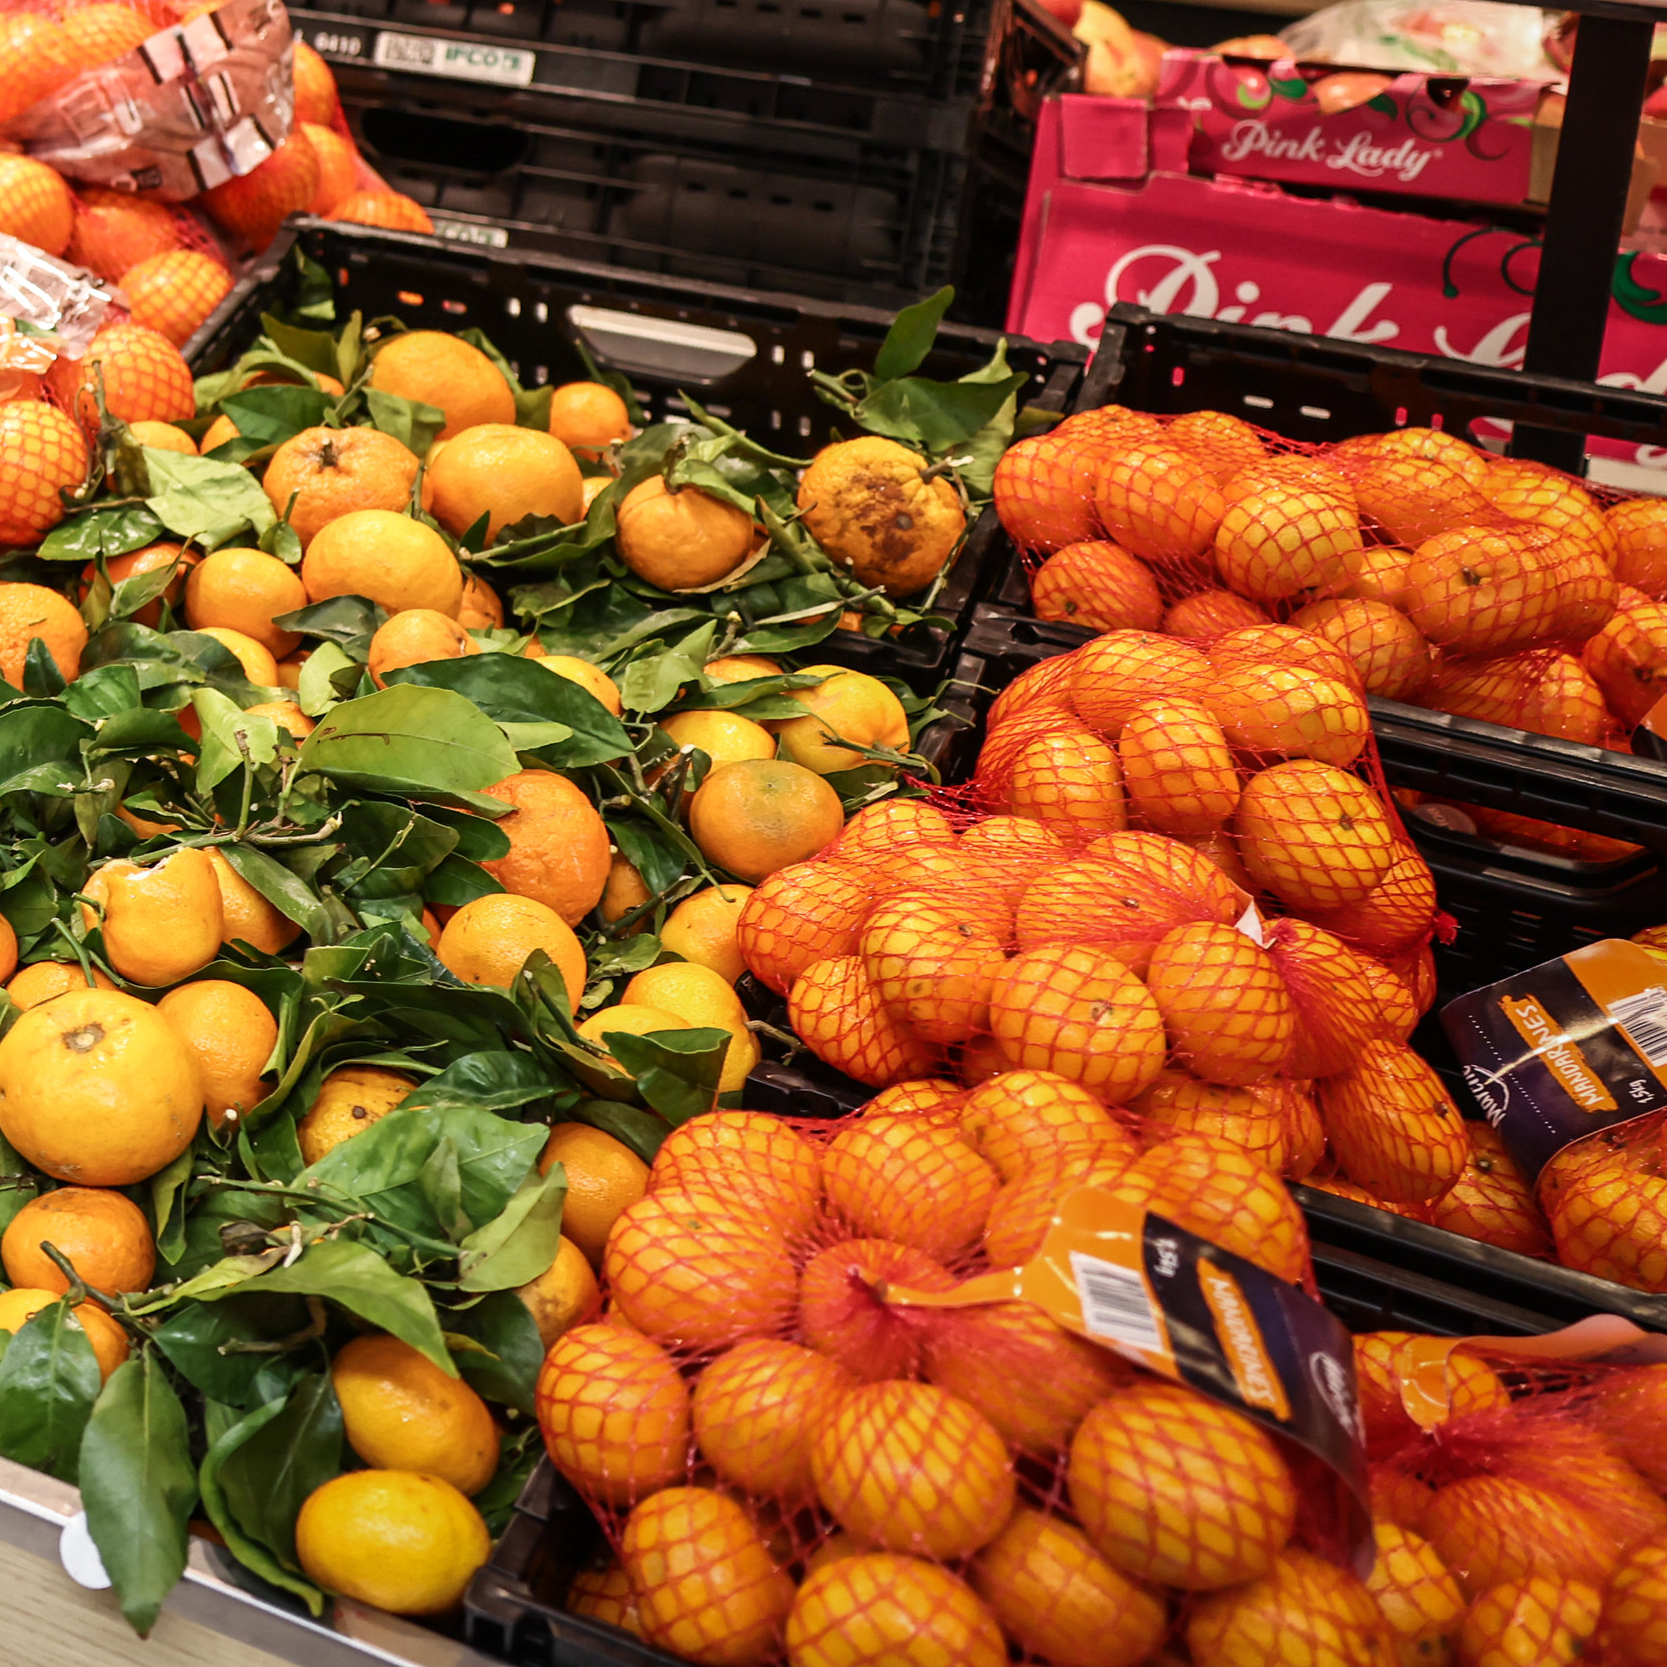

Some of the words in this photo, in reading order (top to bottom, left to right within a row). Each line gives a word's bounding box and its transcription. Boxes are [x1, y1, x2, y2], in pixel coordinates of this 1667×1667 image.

[445, 45, 500, 68] IFCO
[1221, 119, 1327, 163] Pink
[1515, 1004, 1605, 1106] MANDARINES
[1628, 1078, 1656, 1105] 1,5kg
[1206, 1276, 1277, 1404] MANDARINES
